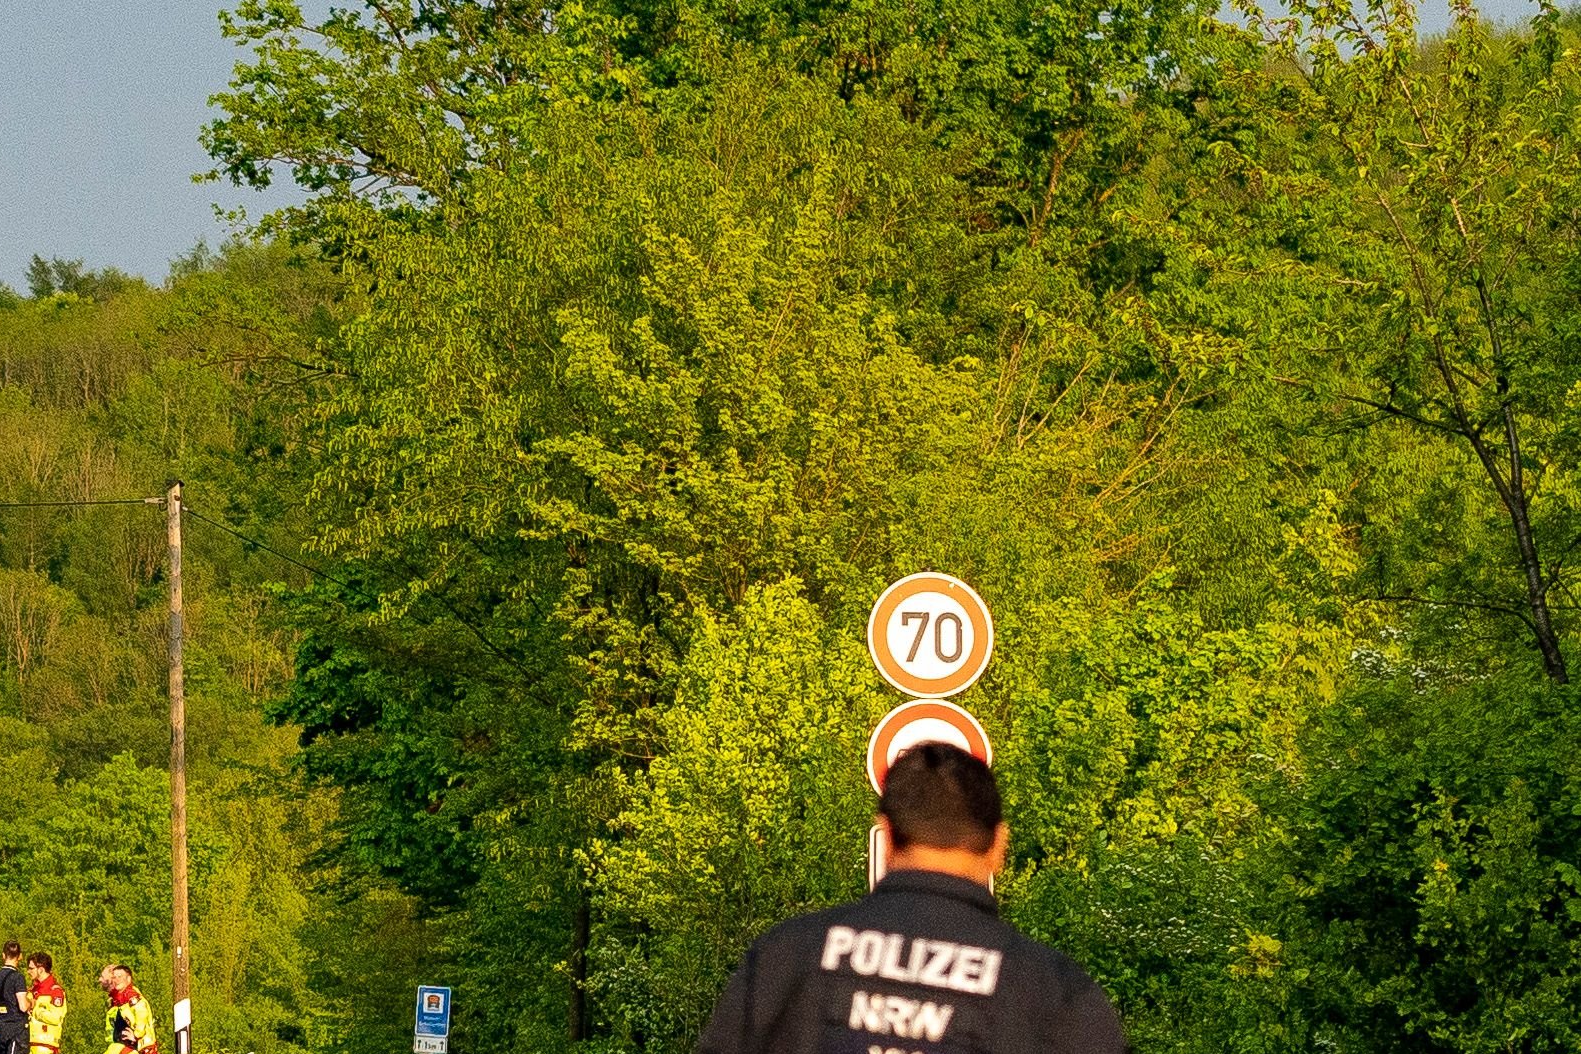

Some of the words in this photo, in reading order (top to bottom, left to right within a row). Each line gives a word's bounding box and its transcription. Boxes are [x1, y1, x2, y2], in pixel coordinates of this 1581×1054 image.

[901, 611, 963, 663] 70
[820, 925, 1003, 996] POLIZEI
[848, 990, 955, 1042] NRW
